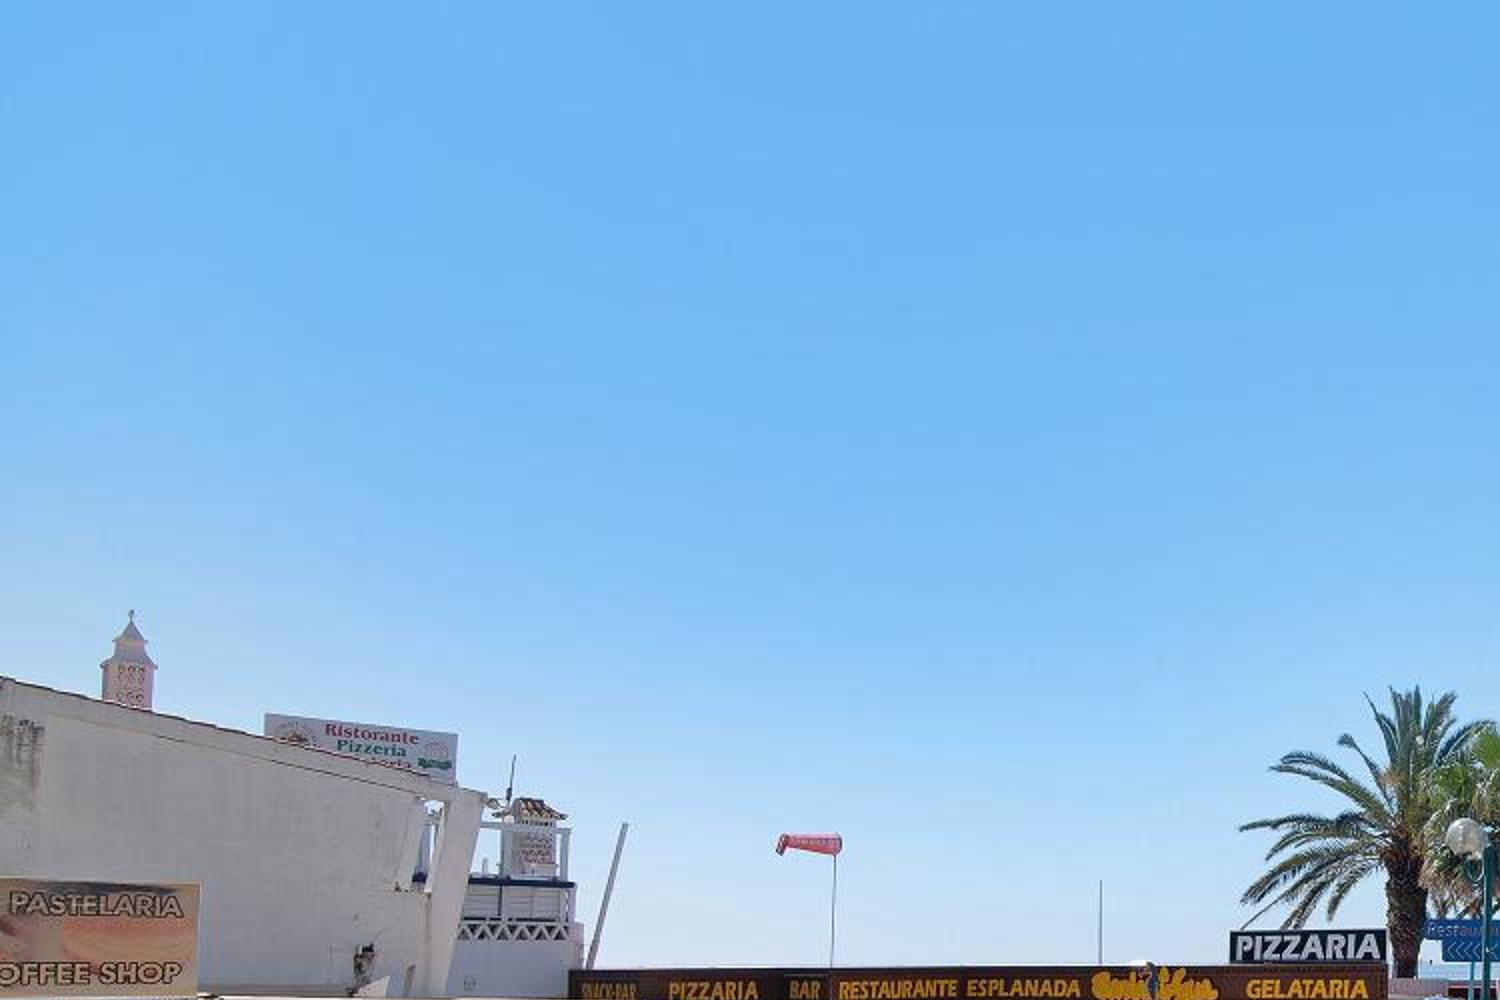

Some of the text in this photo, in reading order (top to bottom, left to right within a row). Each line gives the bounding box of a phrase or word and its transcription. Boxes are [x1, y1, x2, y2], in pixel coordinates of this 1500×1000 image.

[325, 723, 419, 745] Ristorante
[337, 739, 407, 757] Pizzeria
[10, 891, 184, 918] PASTELARIA
[1235, 934, 1381, 961] PIZZARIA
[100, 962, 182, 985] SHOP
[668, 981, 759, 1000] PIZZARIA
[789, 980, 821, 1000] BAR
[839, 979, 958, 999] RESTAURANTE
[967, 978, 1081, 998] ESPLANADA
[1247, 979, 1370, 999] GELATARIA
